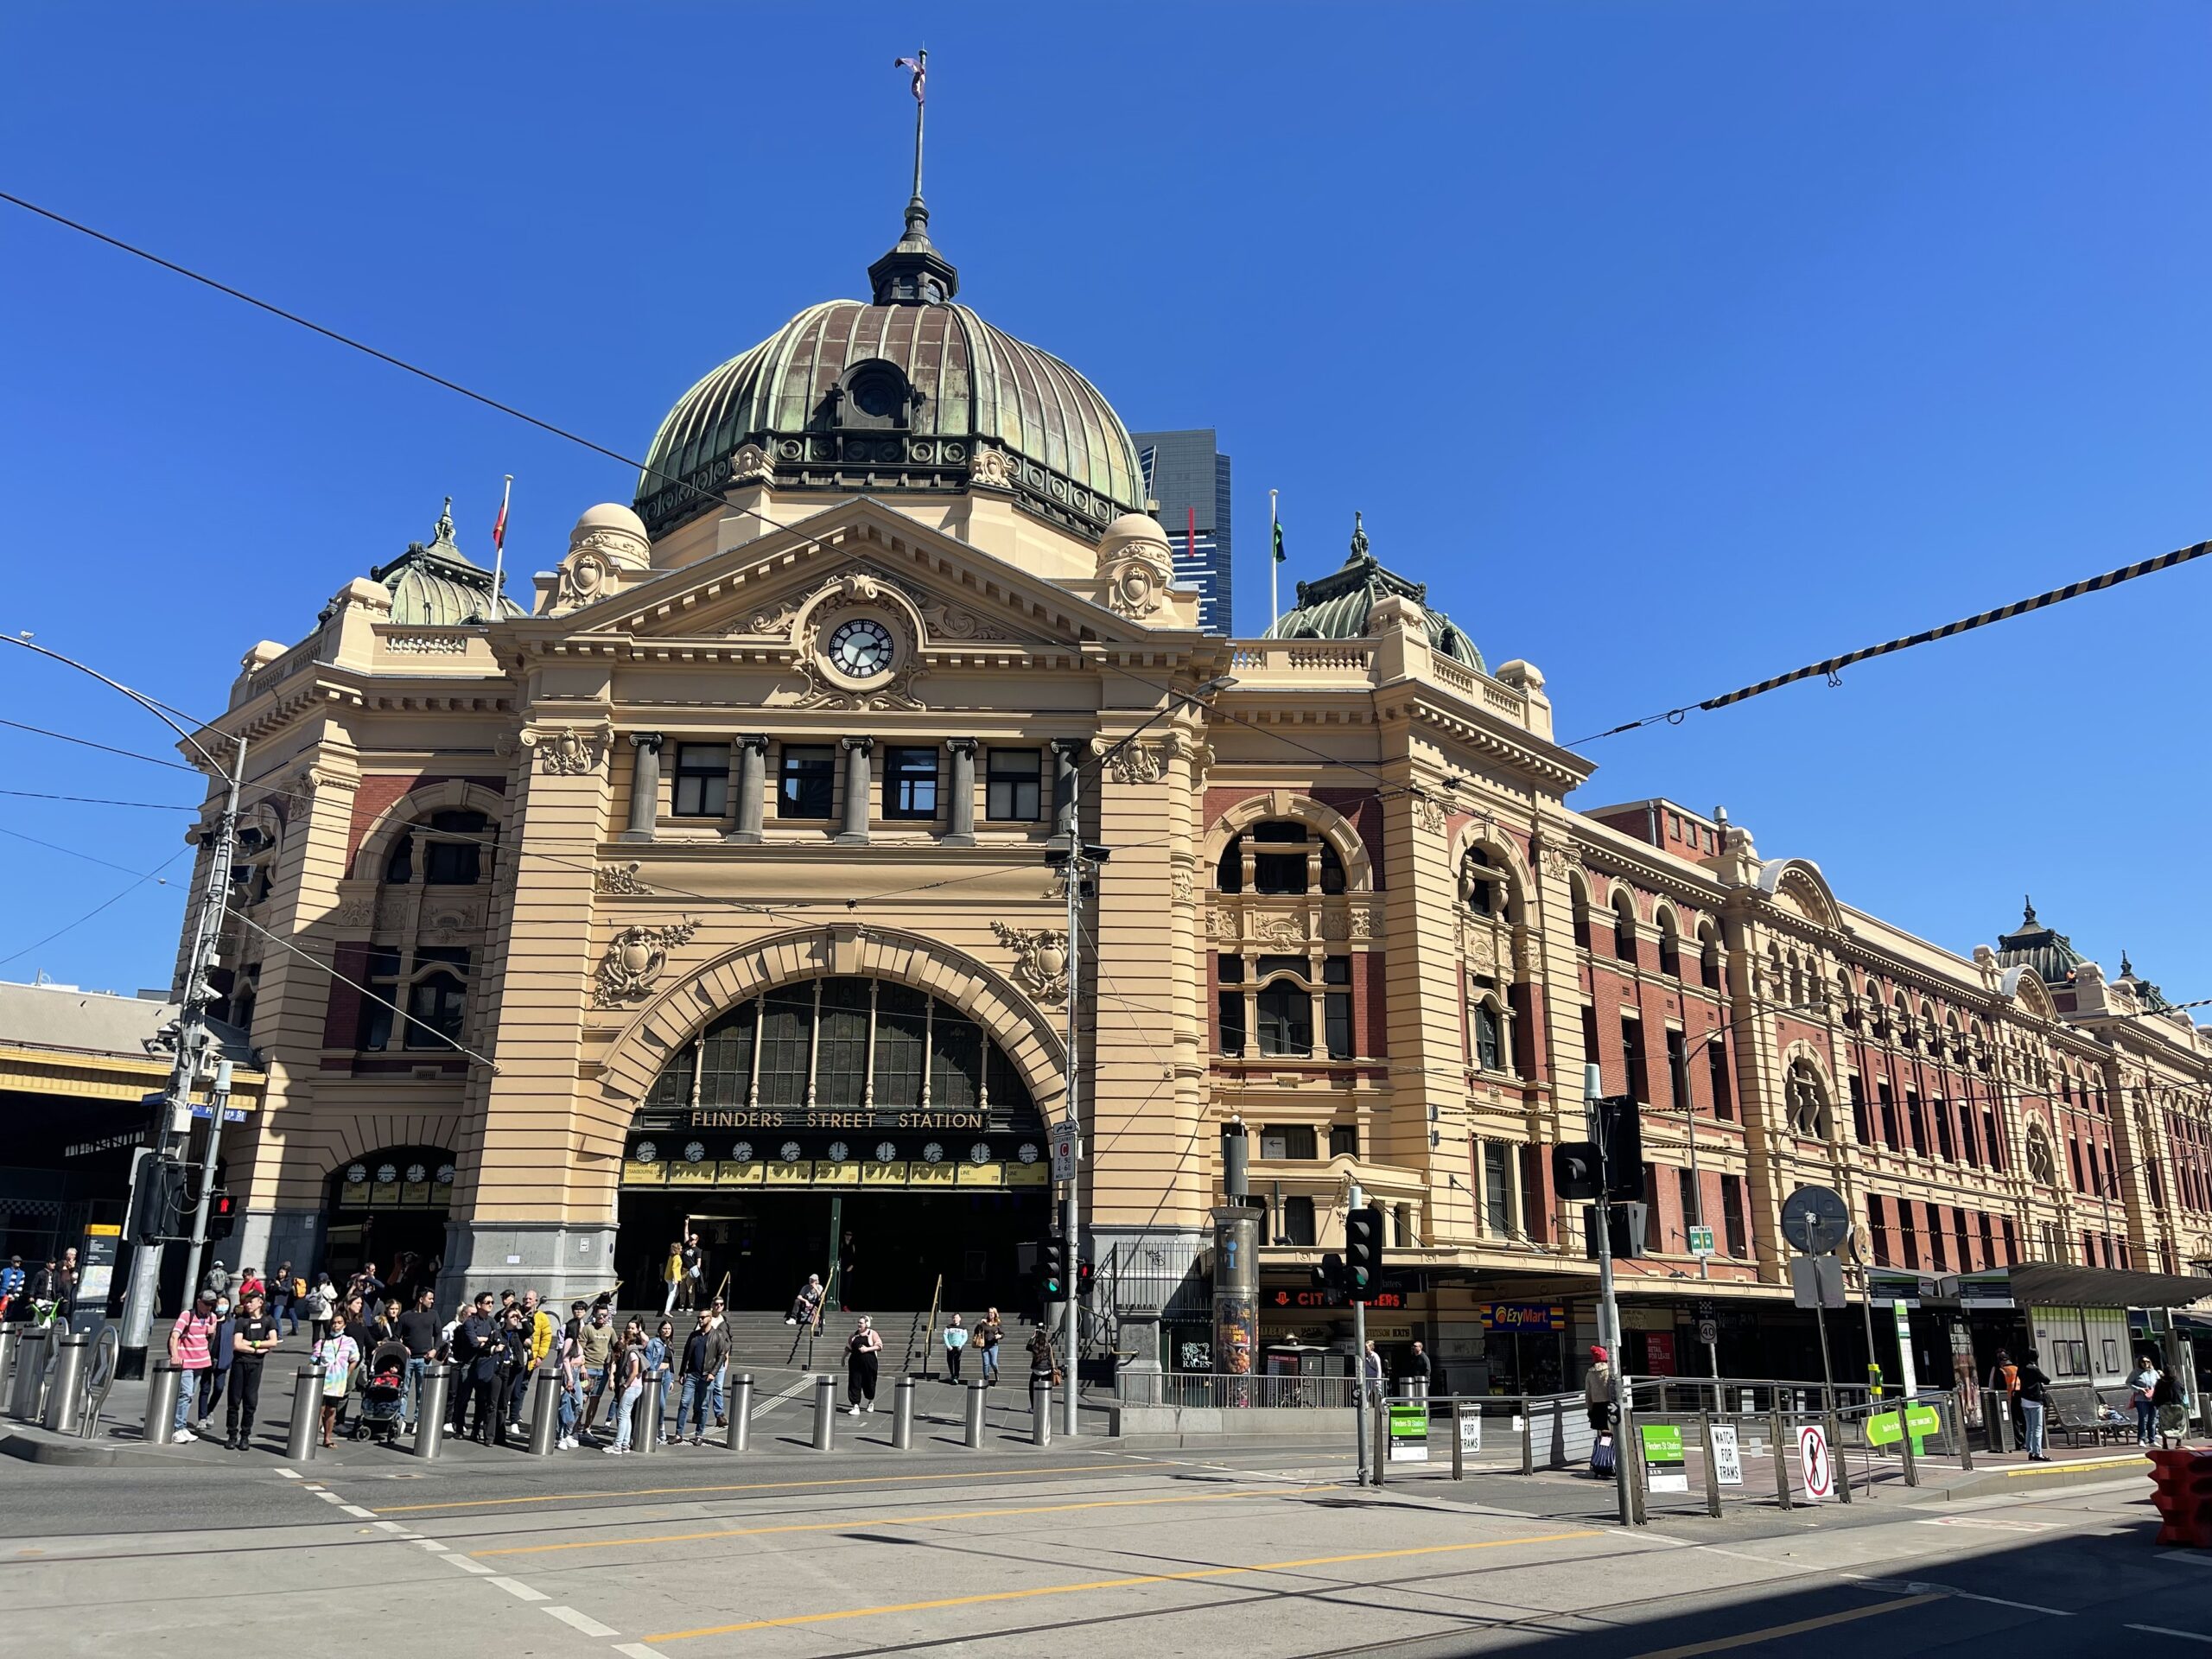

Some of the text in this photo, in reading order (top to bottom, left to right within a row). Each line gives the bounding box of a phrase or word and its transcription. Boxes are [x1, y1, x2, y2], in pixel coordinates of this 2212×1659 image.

[237, 1110, 245, 1119] St
[691, 1112, 982, 1128] FLINDERS STREET STATION
[1183, 1357, 1211, 1368] RACES
[1460, 1410, 1478, 1421] WATCH
[1464, 1424, 1475, 1435] FOR
[1460, 1438, 1478, 1449] TRAMS
[1713, 1431, 1734, 1445] WATCH
[1720, 1448, 1733, 1462] FOR
[1719, 1465, 1739, 1479] TRAMS
